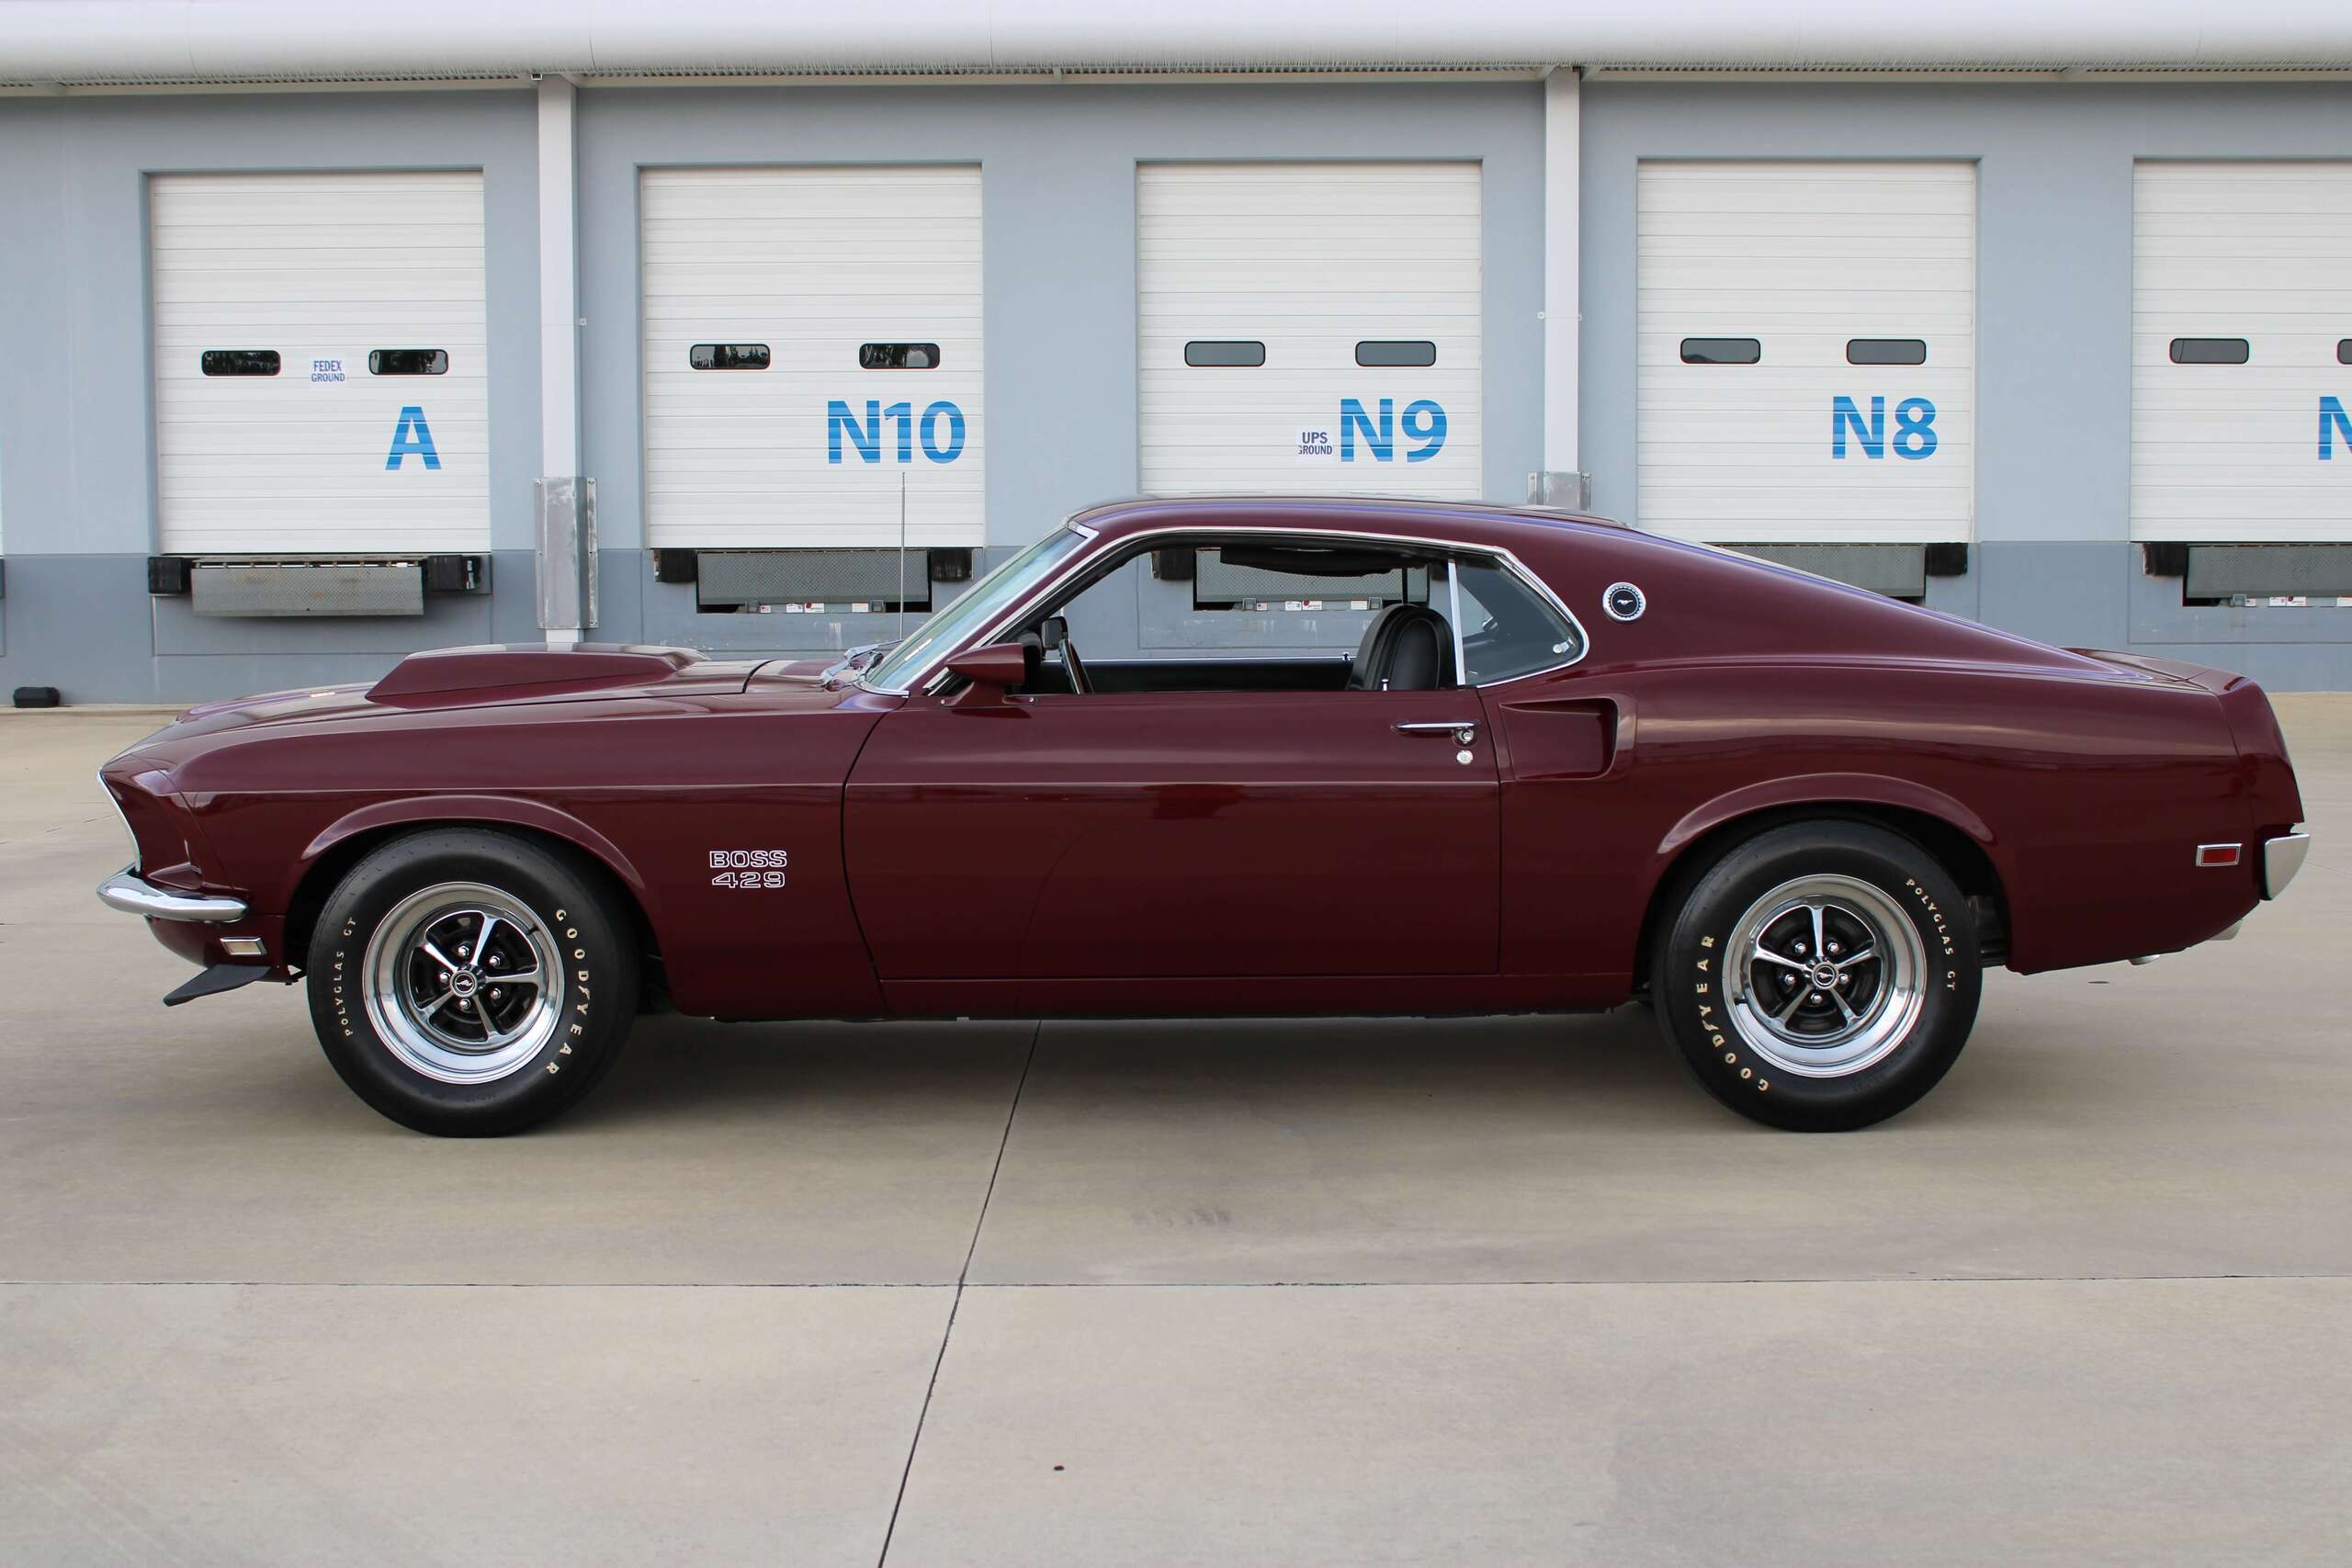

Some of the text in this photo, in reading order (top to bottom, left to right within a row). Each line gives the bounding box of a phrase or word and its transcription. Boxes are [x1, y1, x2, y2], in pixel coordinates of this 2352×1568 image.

[311, 373, 345, 382] GROUND
[313, 360, 343, 372] FEDEX
[385, 406, 442, 470] A
[827, 400, 966, 464] N10
[1302, 432, 1328, 444] UPS
[1340, 399, 1448, 463] N9
[1832, 396, 1938, 460] N8
[709, 850, 787, 868] BOSS
[712, 871, 786, 888] 429
[1905, 878, 1956, 991] POLYGLAS GT
[334, 916, 357, 1037] POLYGLAS GT
[546, 908, 591, 1075] GOODYEAR
[1696, 935, 1770, 1091] GOODYEAR
